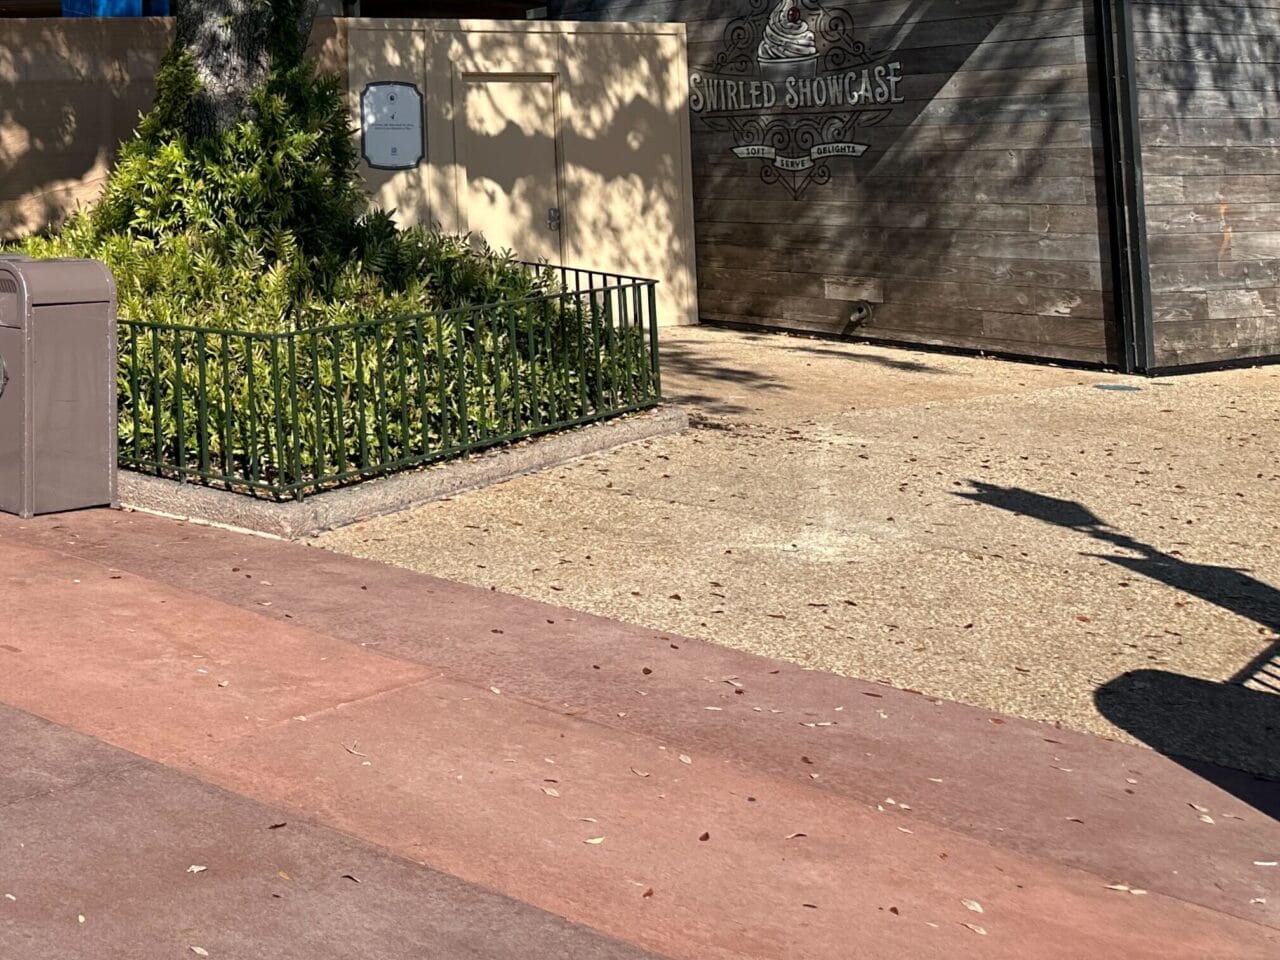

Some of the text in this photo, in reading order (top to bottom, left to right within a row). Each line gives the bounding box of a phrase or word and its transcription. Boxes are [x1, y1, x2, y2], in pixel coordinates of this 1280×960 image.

[689, 62, 905, 112] SWIRLED SHOWCASE
[745, 145, 766, 156] SOFT
[816, 144, 857, 155] DELIGHTS
[780, 158, 807, 168] SERVE
